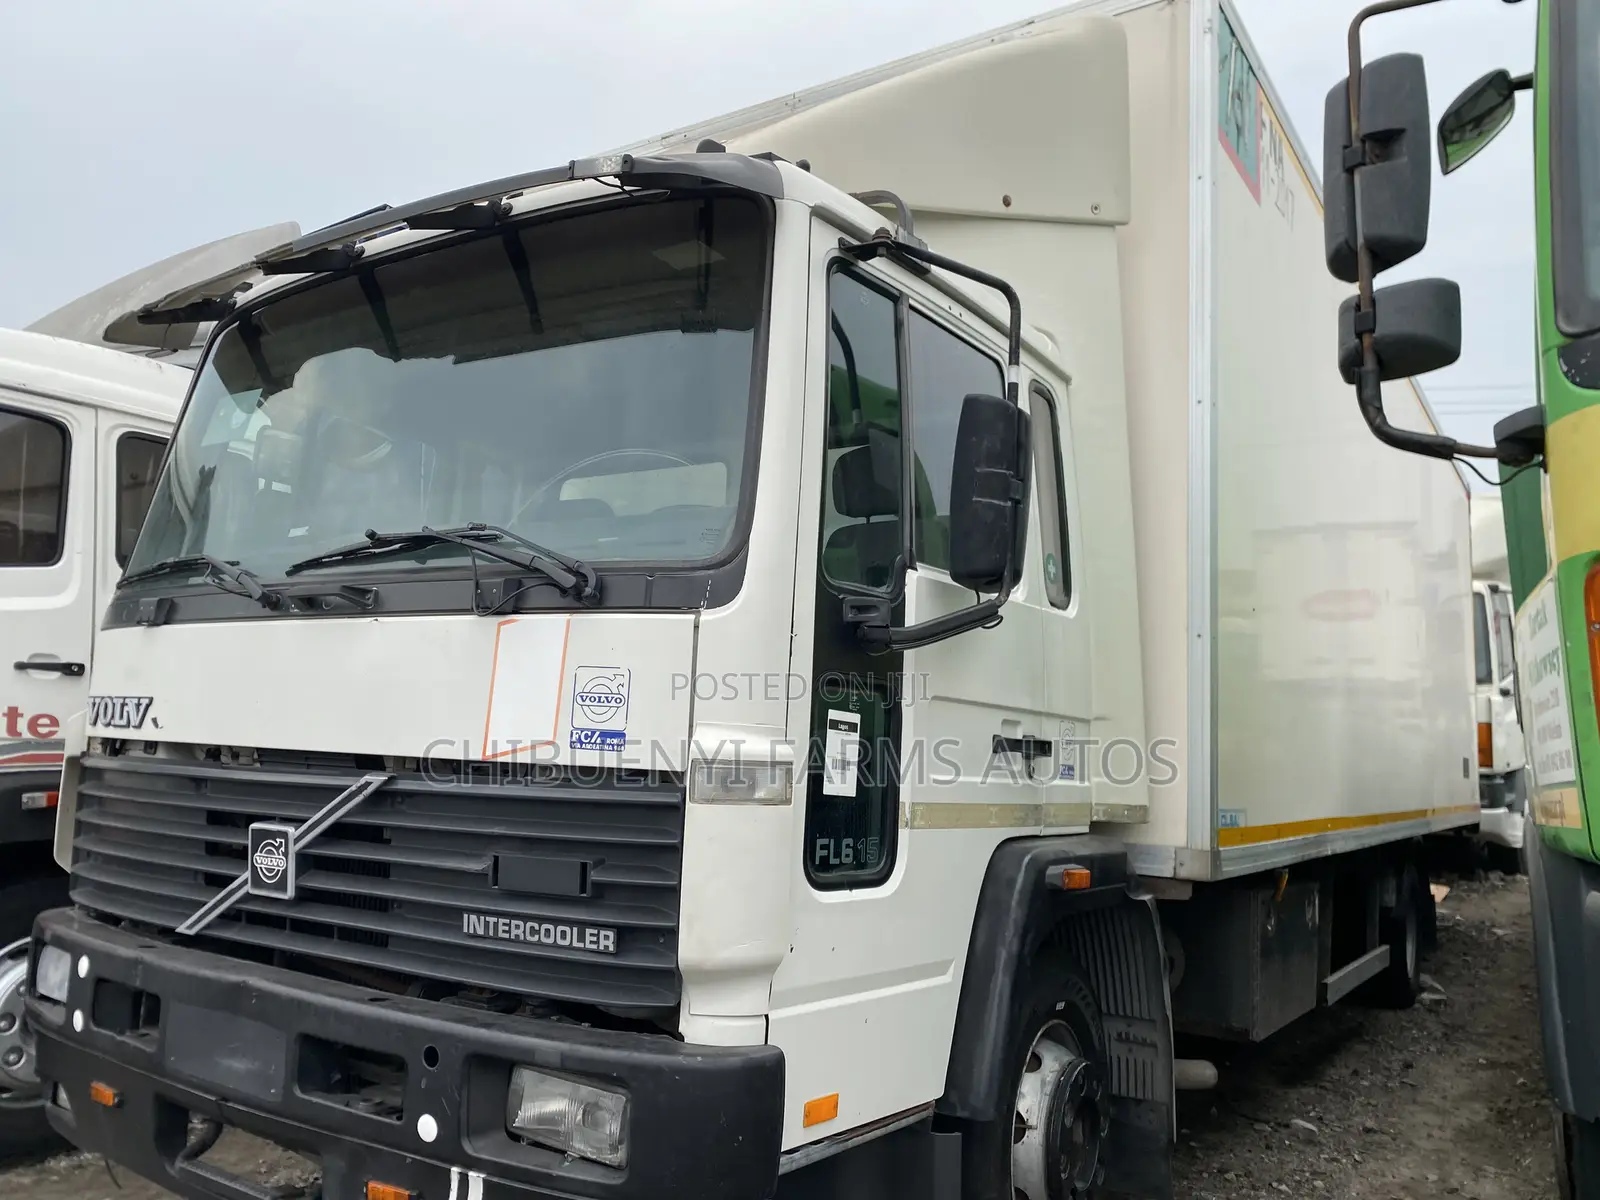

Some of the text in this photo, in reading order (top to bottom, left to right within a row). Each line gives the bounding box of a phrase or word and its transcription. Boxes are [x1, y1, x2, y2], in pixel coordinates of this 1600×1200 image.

[87, 696, 163, 728] VOLV
[579, 695, 623, 704] VOLVO
[2, 706, 60, 739] te
[255, 856, 284, 867] VOLVO
[857, 837, 879, 863] 15
[462, 913, 615, 951] INTERCOOLER
